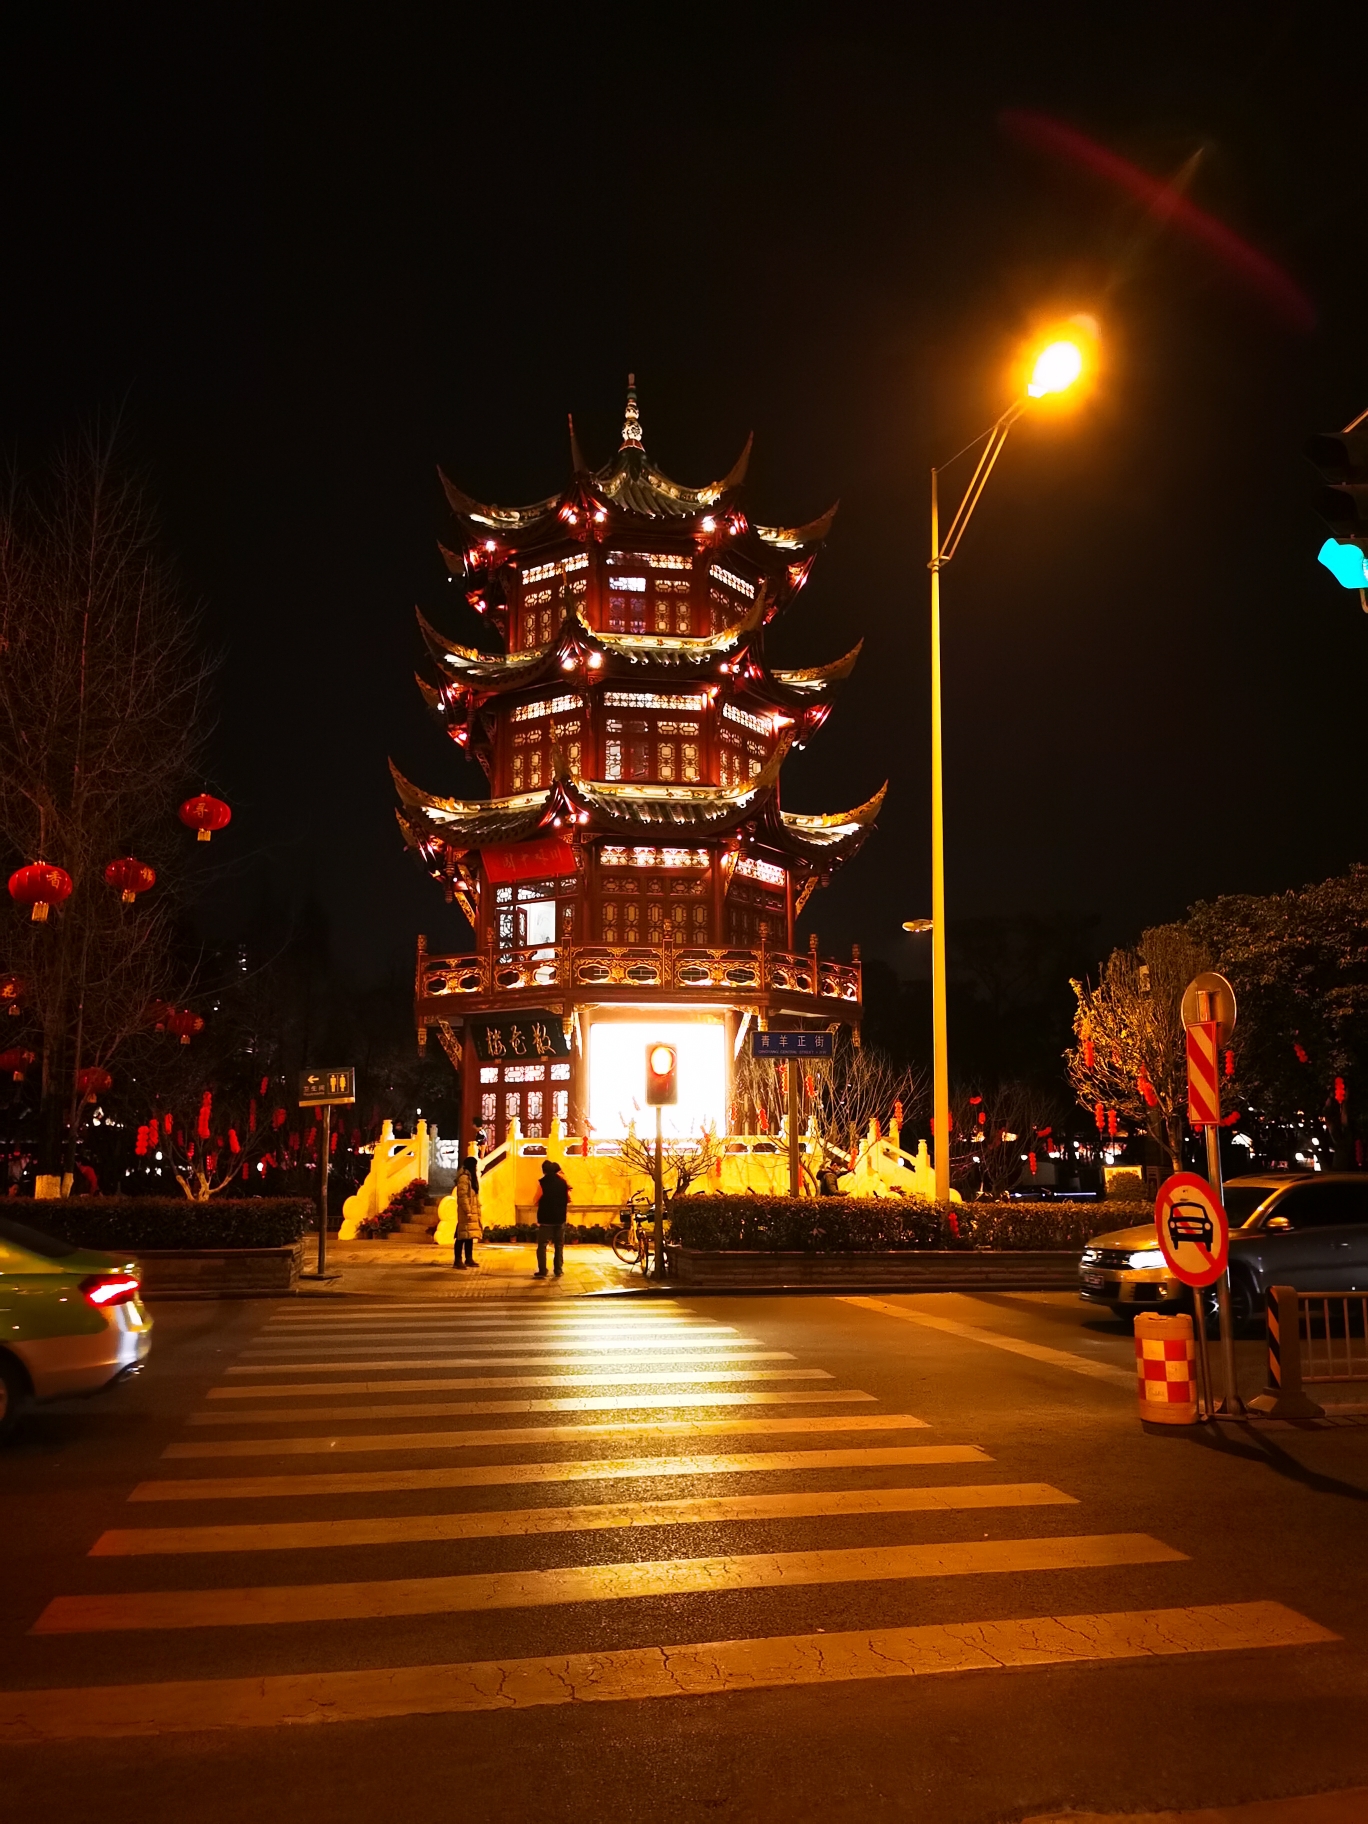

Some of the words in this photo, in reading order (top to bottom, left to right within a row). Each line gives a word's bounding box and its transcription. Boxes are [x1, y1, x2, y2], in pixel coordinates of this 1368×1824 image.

[193, 802, 209, 818] 寻
[46, 871, 62, 889] 香
[761, 1034, 825, 1048] 青羊正街
[303, 1084, 326, 1092] 卫生间
